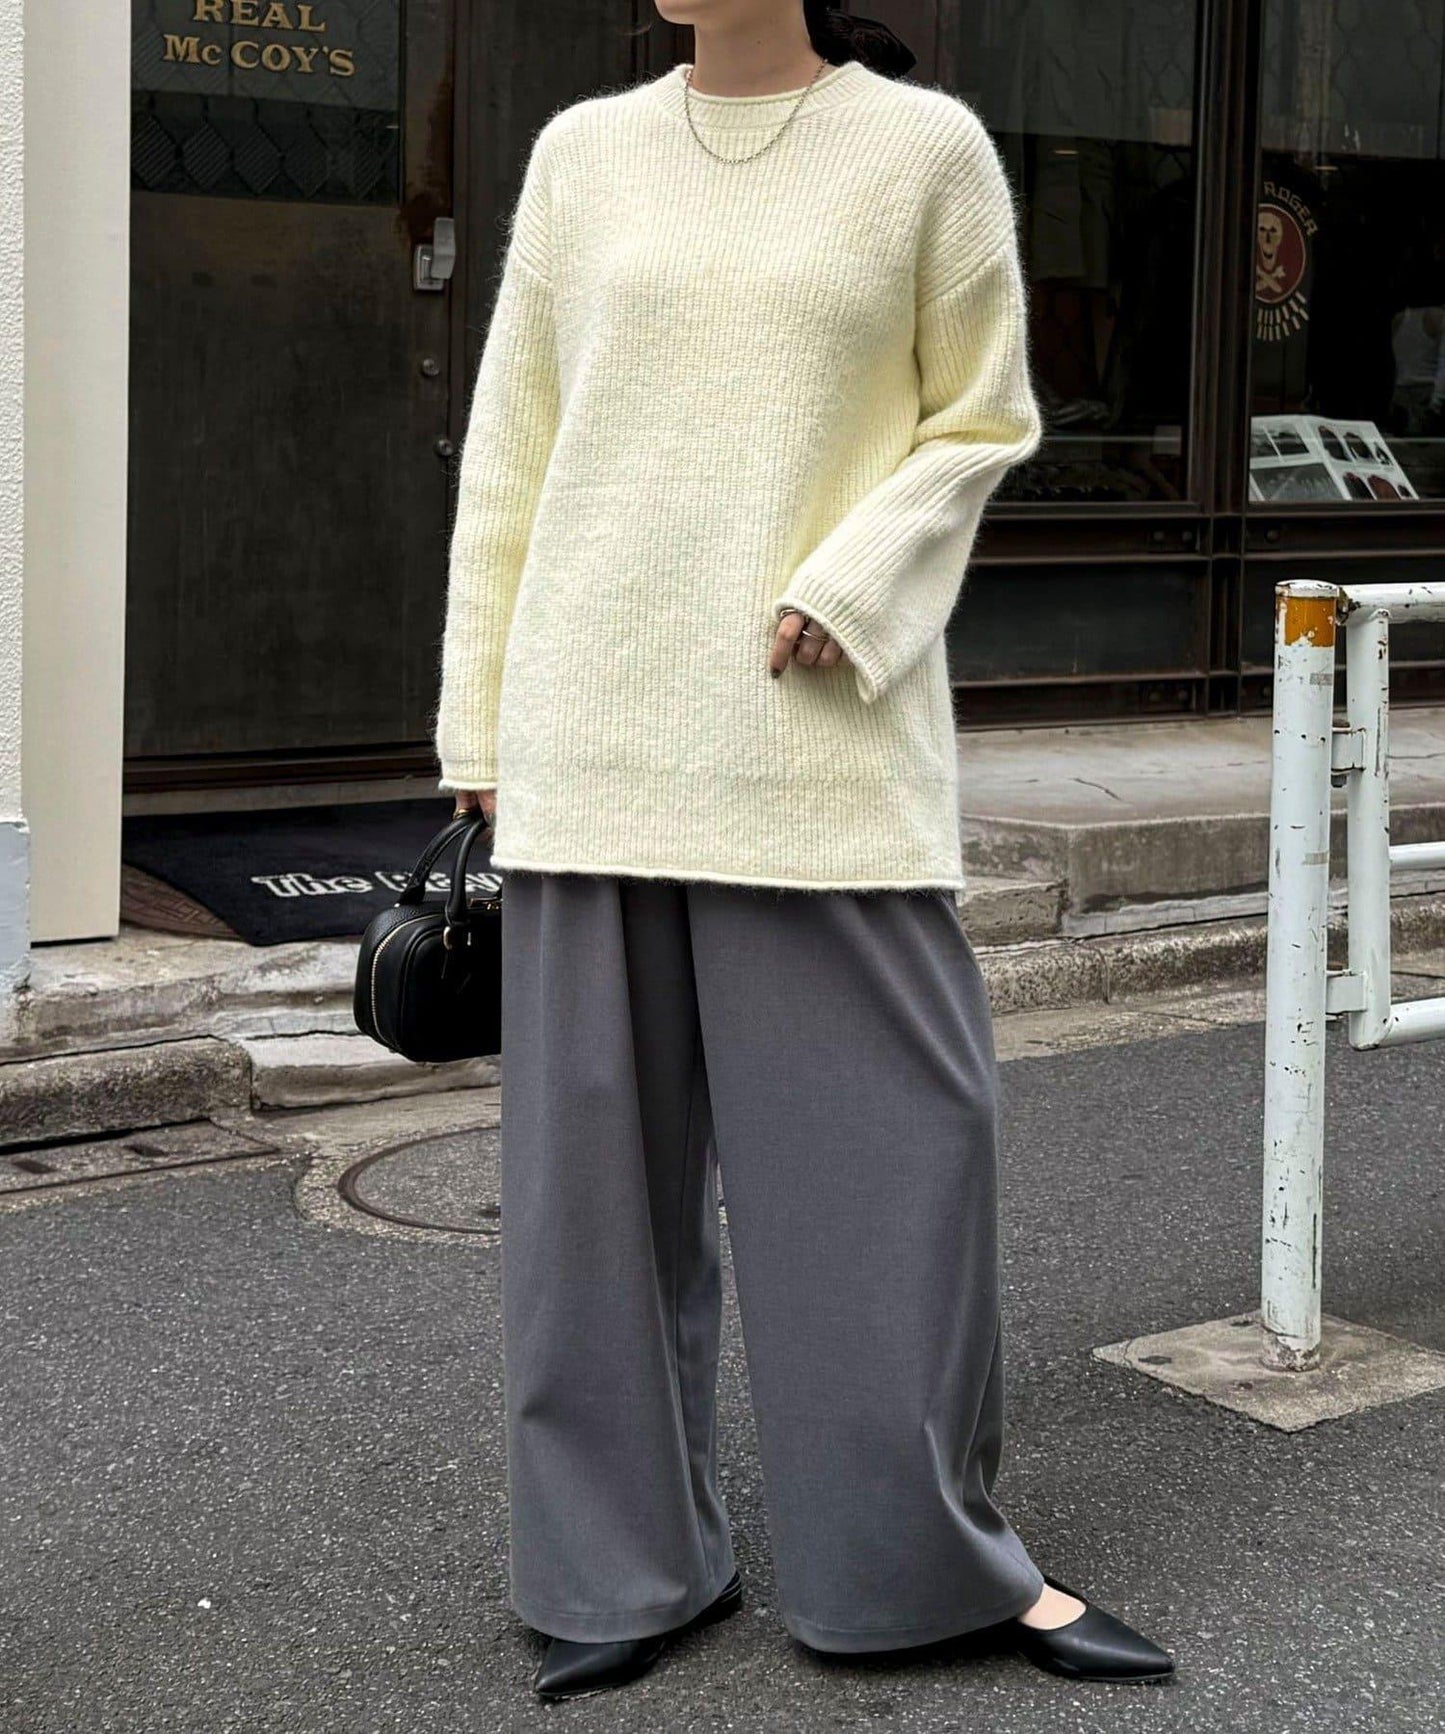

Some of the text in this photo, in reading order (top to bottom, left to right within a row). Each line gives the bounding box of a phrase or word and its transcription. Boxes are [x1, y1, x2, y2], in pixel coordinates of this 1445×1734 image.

[193, 0, 326, 32] REAL
[1263, 181, 1318, 236] ROGER
[251, 872, 373, 898] The
